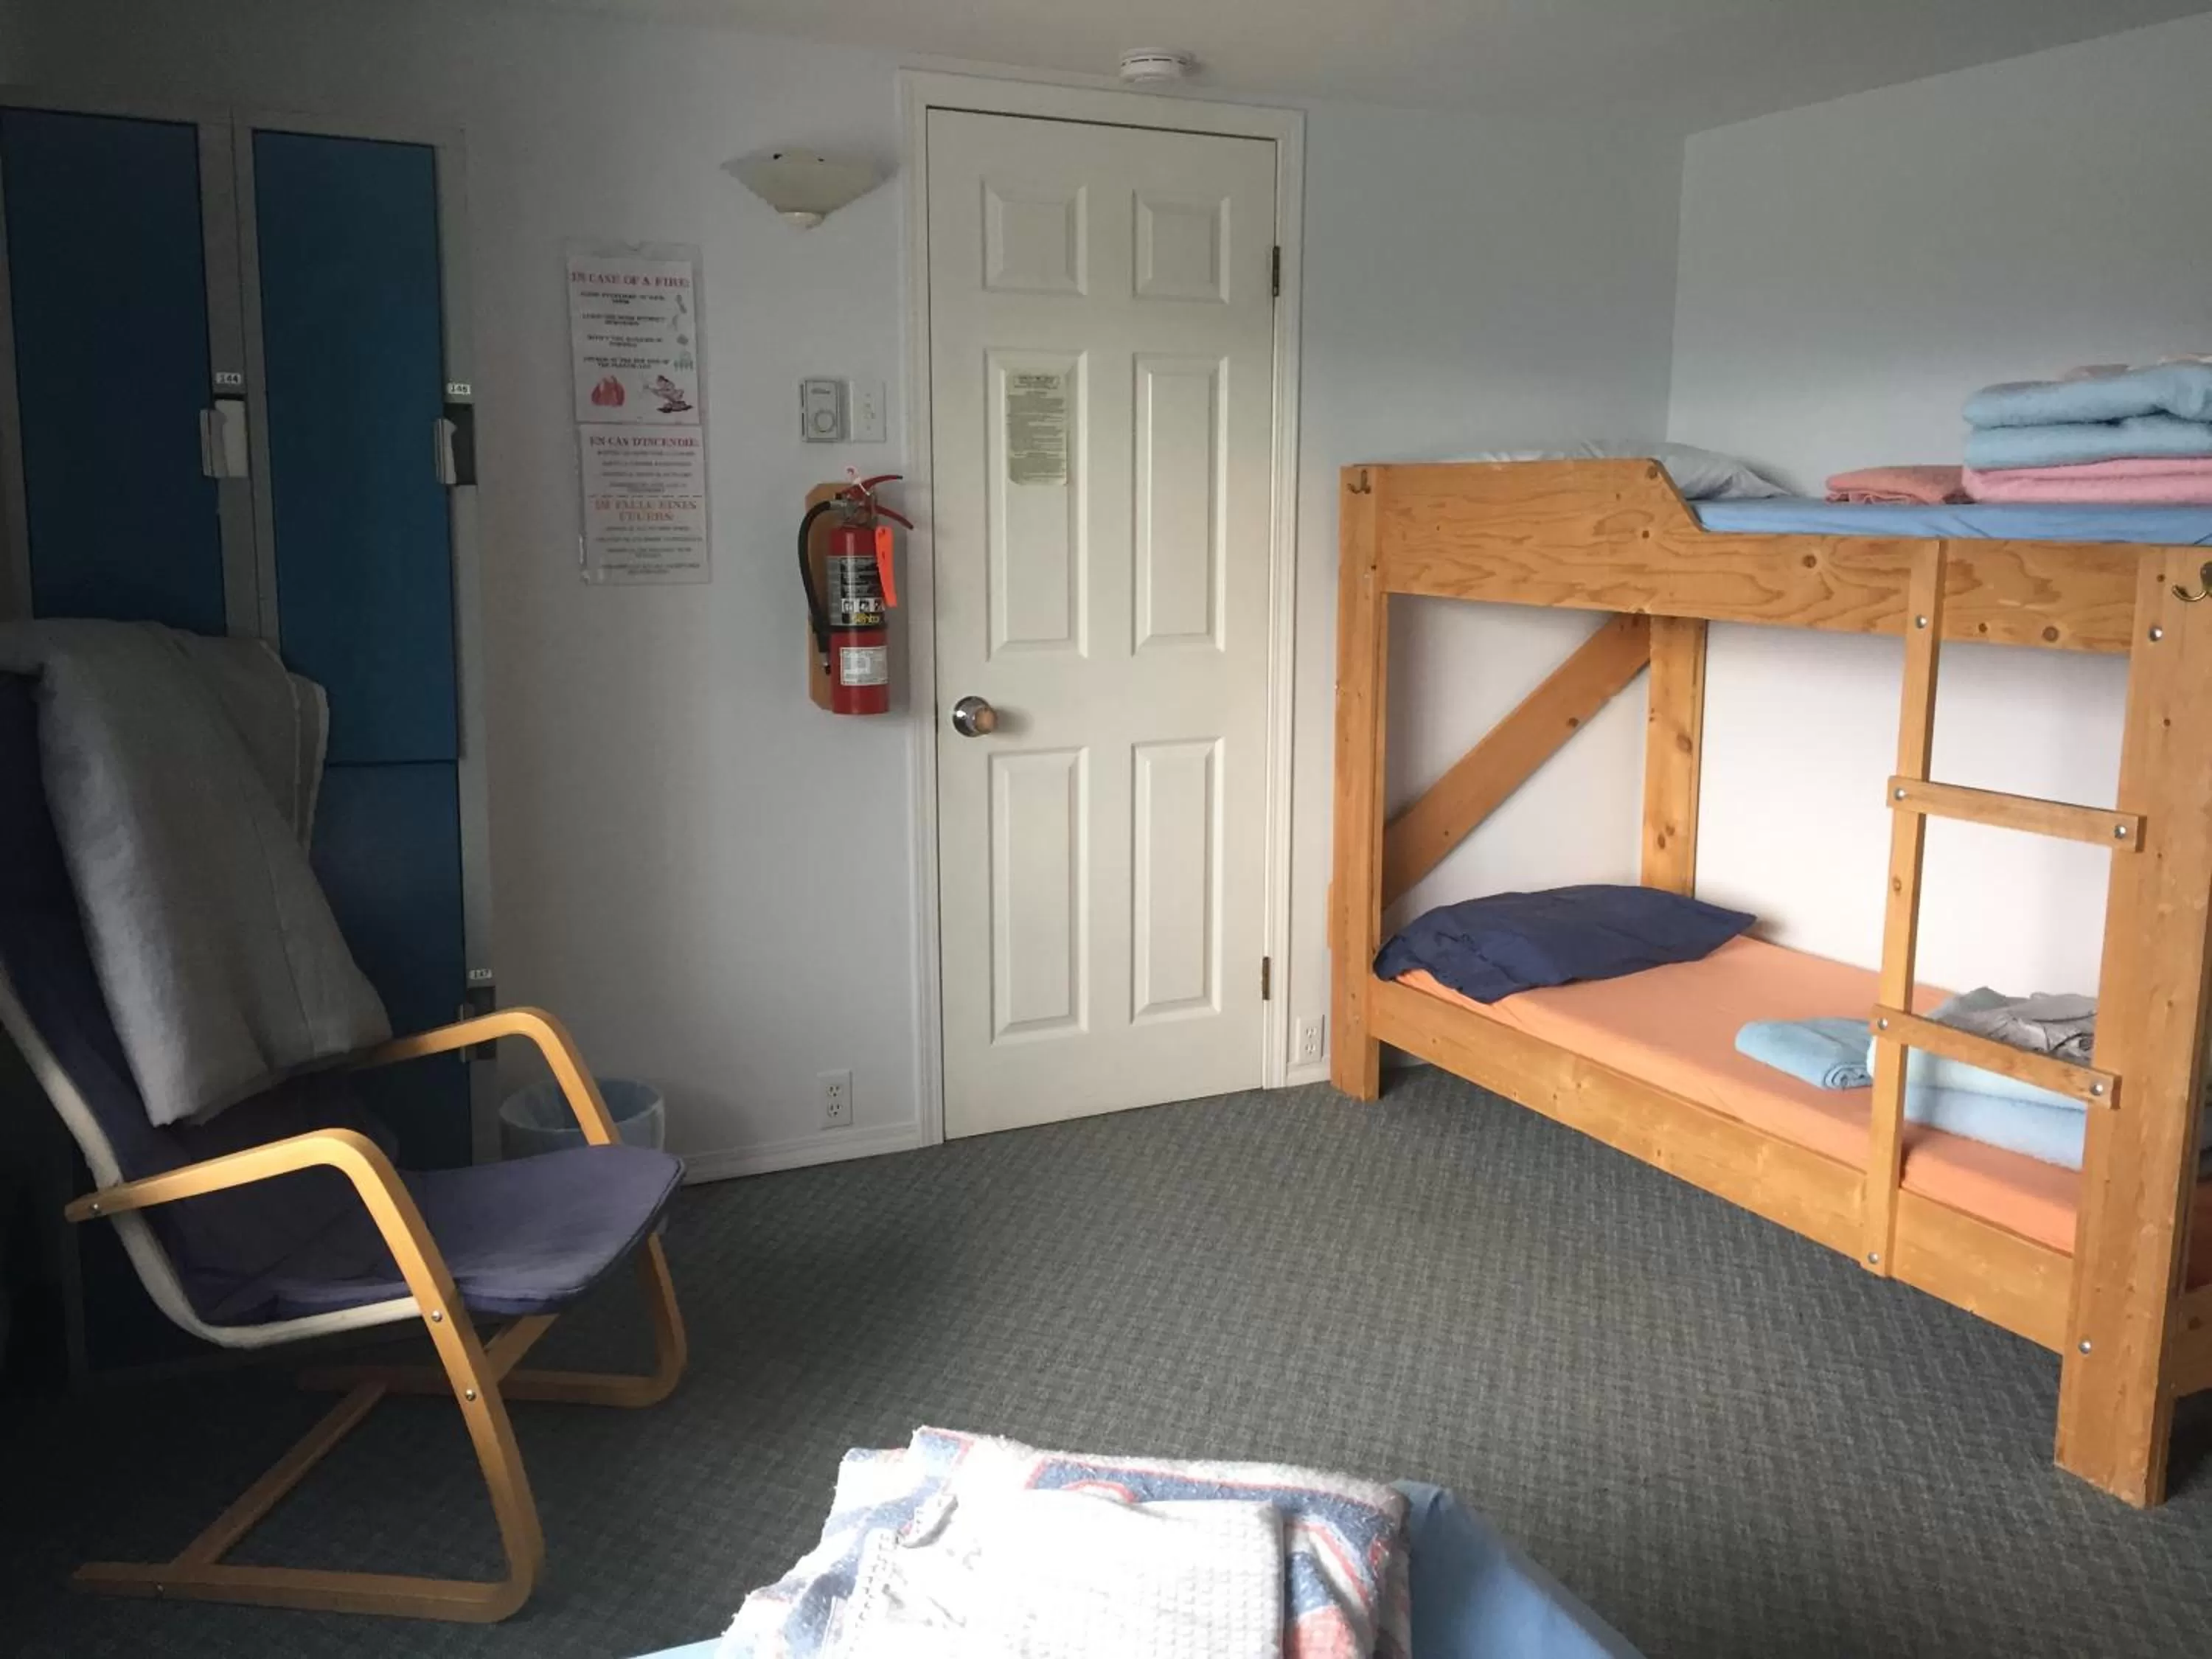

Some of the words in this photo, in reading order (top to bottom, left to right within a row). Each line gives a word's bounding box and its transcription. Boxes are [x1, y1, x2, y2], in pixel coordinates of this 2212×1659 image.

[571, 271, 585, 283] IN
[589, 273, 619, 284] CASE
[623, 275, 639, 285] OF
[642, 276, 651, 286] A
